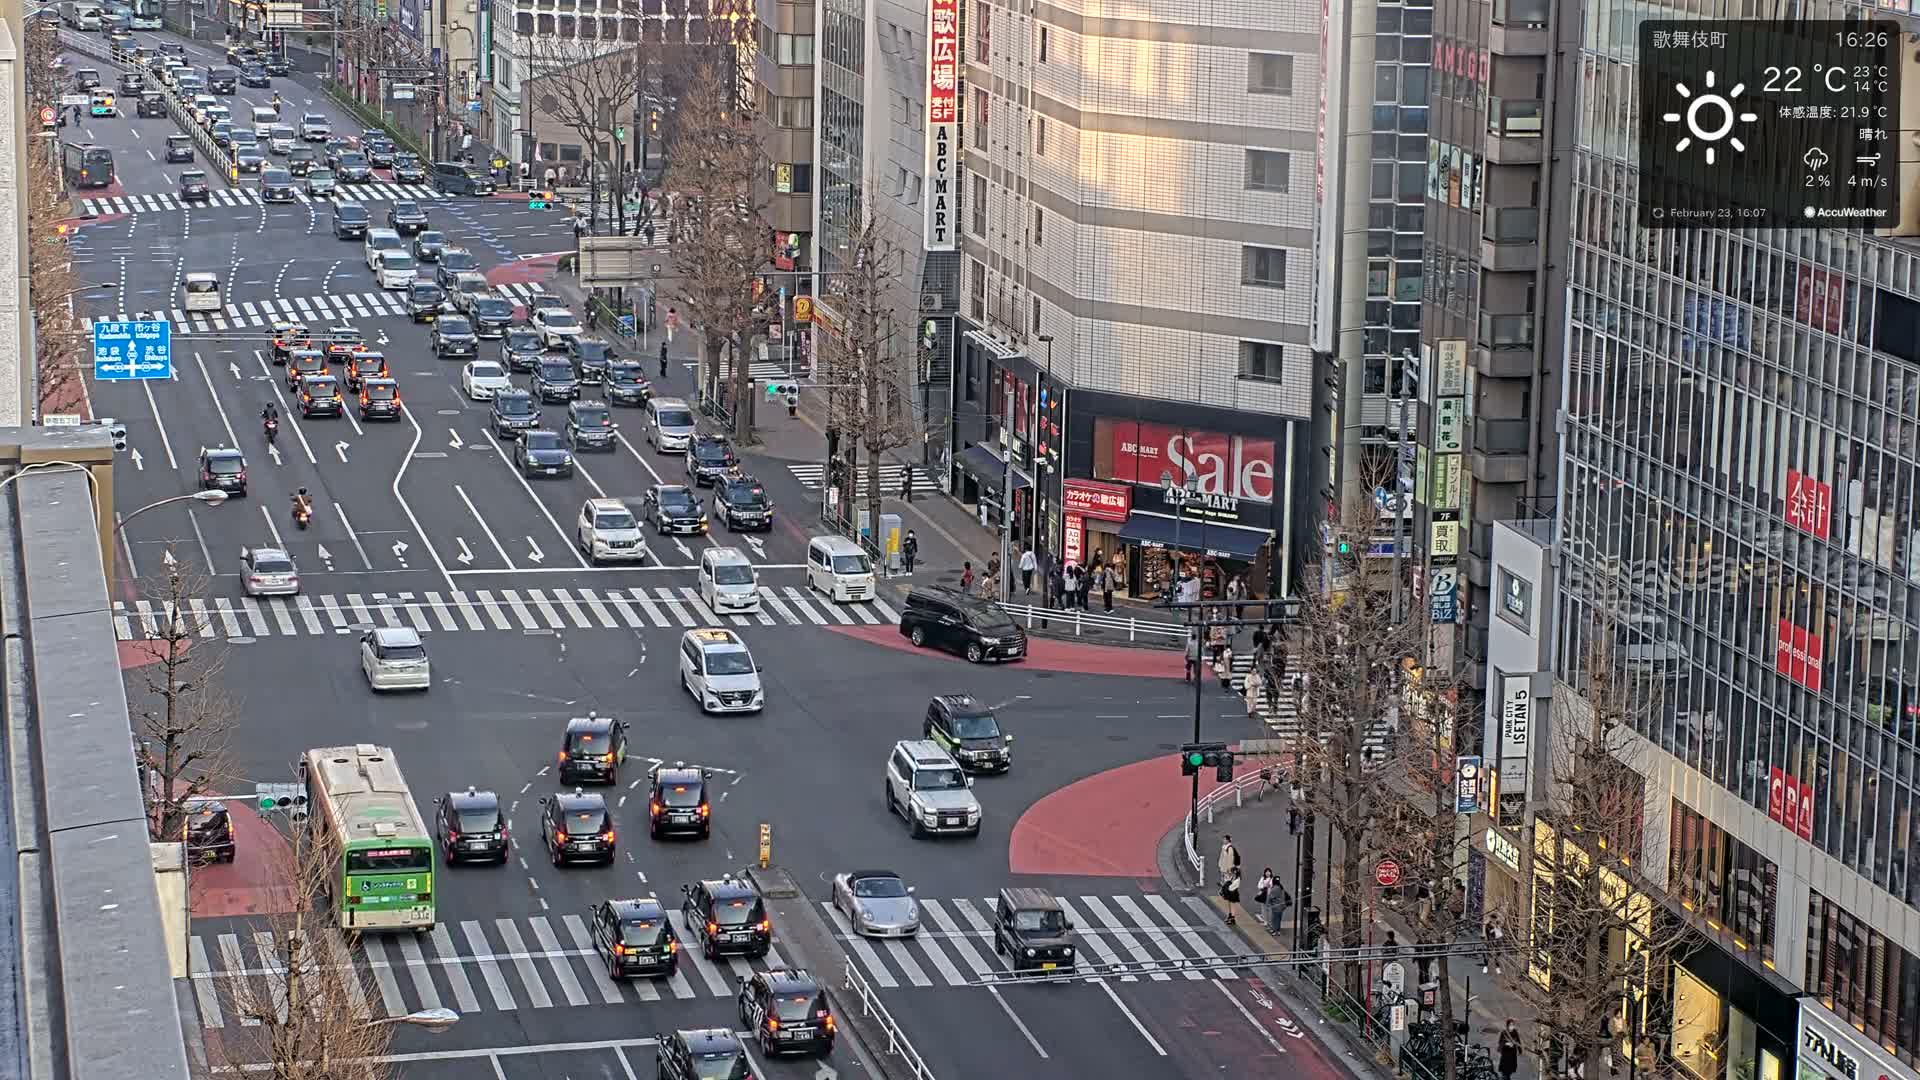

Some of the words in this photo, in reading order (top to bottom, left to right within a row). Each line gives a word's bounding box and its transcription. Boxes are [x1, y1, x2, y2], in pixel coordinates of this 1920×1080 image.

[933, 0, 955, 90] 歌広場
[1434, 42, 1487, 80] AMIGO
[932, 109, 953, 118] 5F
[935, 126, 947, 242] ABC-MART
[1168, 435, 1273, 500] Sale
[1440, 512, 1451, 520] 7F
[1790, 481, 1826, 528] 会計
[1435, 525, 1448, 552] 買取
[1506, 700, 1514, 718] CITY
[1516, 690, 1528, 700] 5
[1504, 721, 1512, 738] PARK
[1513, 702, 1527, 745] ISETAN
[1772, 778, 1811, 826] CPA
